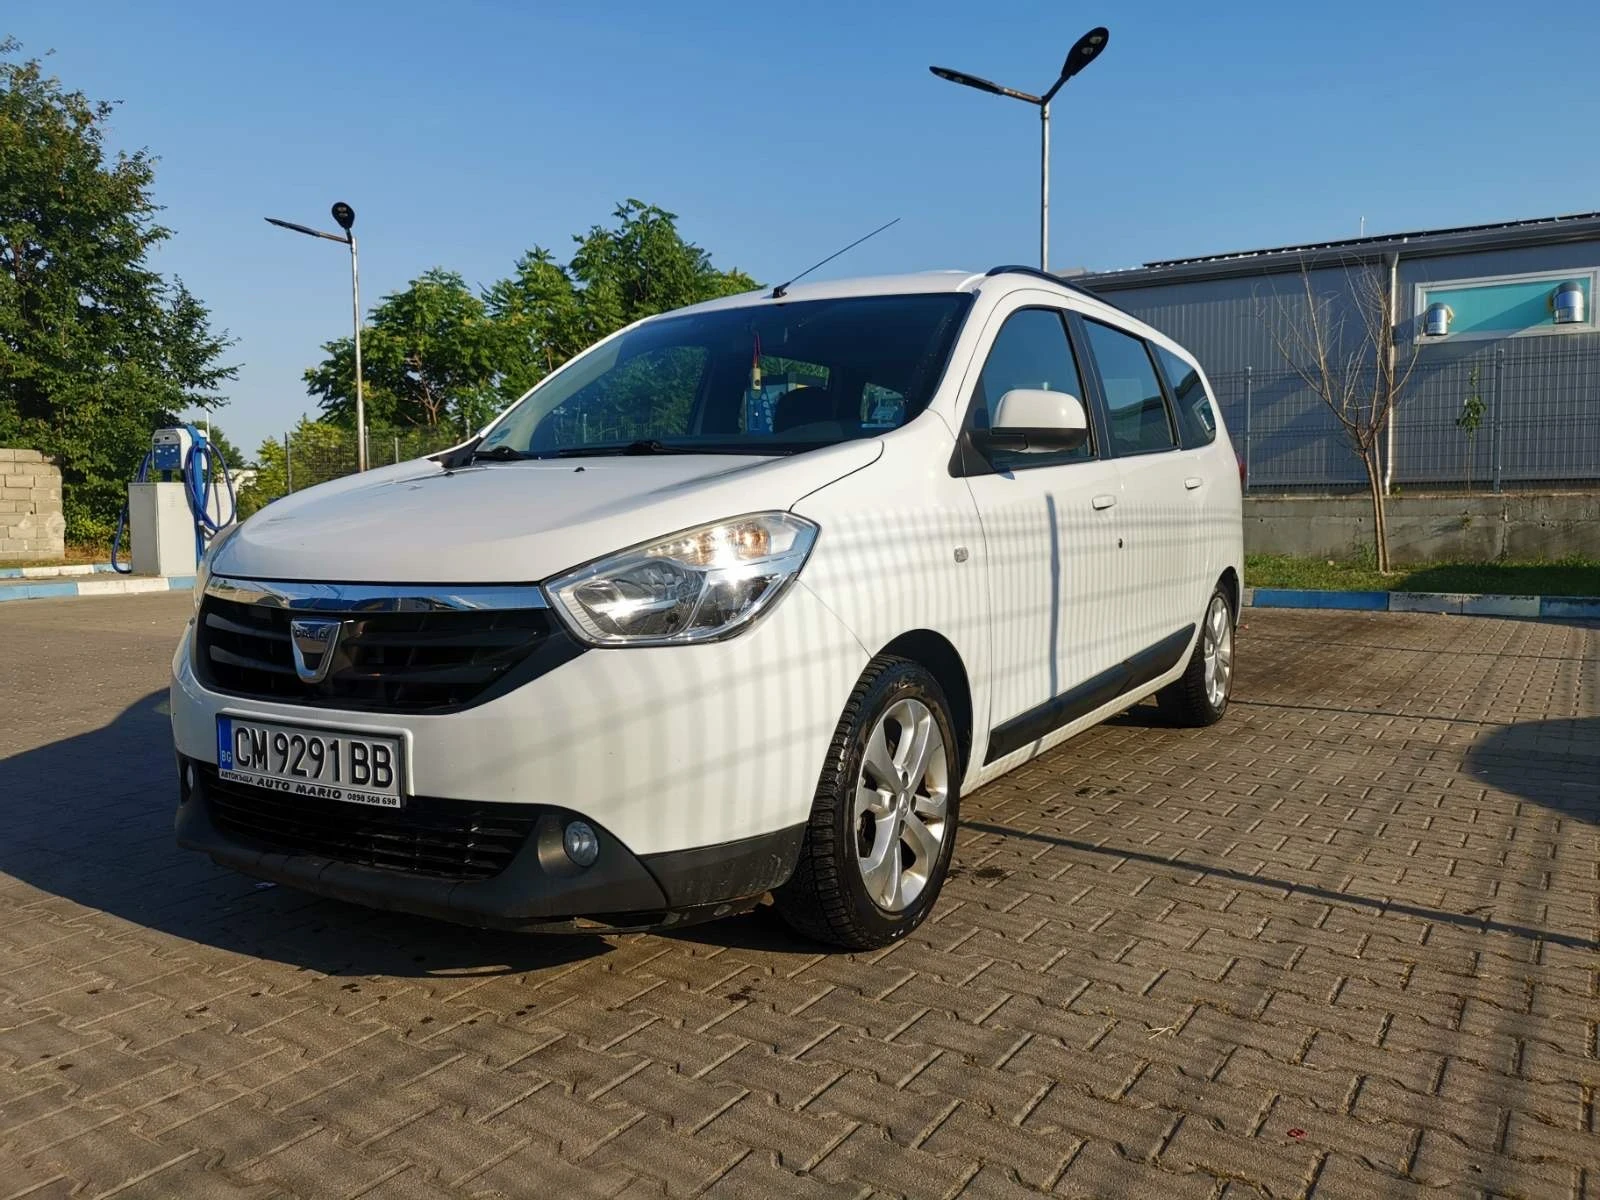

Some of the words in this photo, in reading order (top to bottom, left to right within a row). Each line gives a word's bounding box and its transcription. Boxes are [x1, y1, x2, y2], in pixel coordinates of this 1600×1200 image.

[221, 750, 232, 763] BG
[256, 778, 290, 791] AUTO
[295, 784, 342, 799] MARIO
